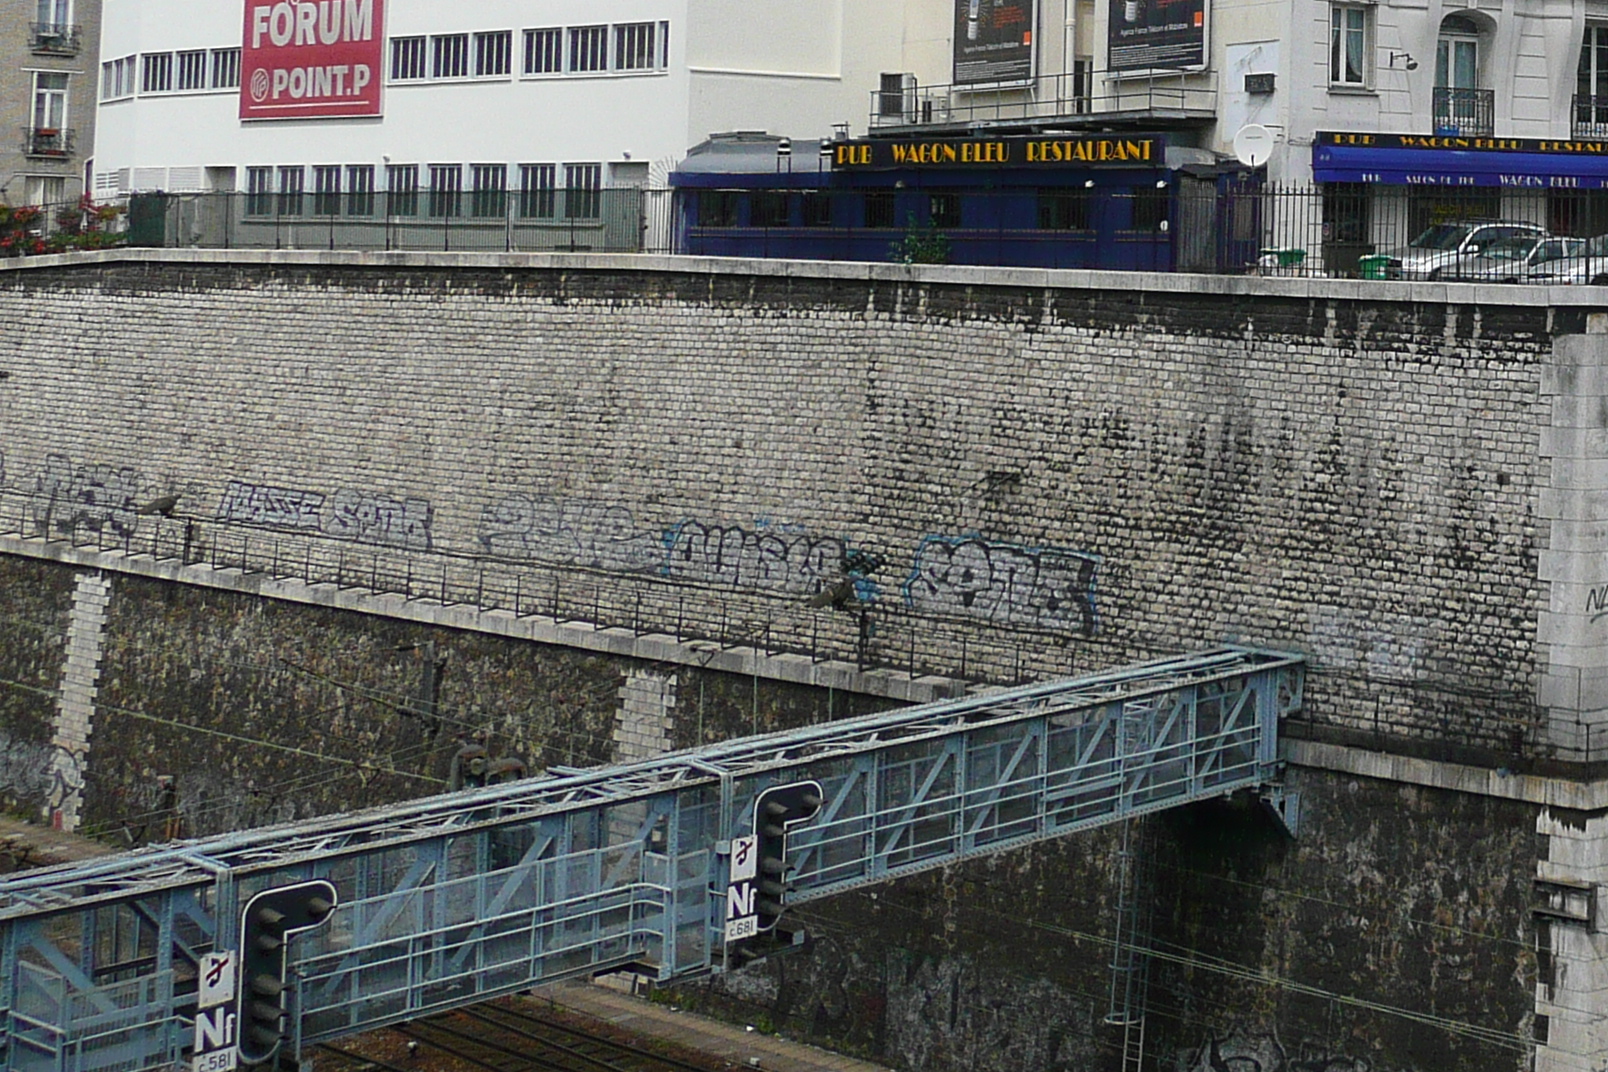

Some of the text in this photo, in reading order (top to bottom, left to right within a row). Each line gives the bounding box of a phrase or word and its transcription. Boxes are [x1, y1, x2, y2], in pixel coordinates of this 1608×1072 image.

[272, 64, 370, 99] POINT.P
[837, 139, 1154, 164] PUB WAGON BLEU RESTAURANT
[1333, 133, 1376, 145] PUB
[1400, 135, 1469, 148] WAGON
[1474, 138, 1523, 150] BLEU
[1499, 174, 1543, 187] WAGON
[1550, 176, 1581, 188] BLEU
[727, 882, 758, 919] Nf
[194, 1006, 237, 1053] Nf
